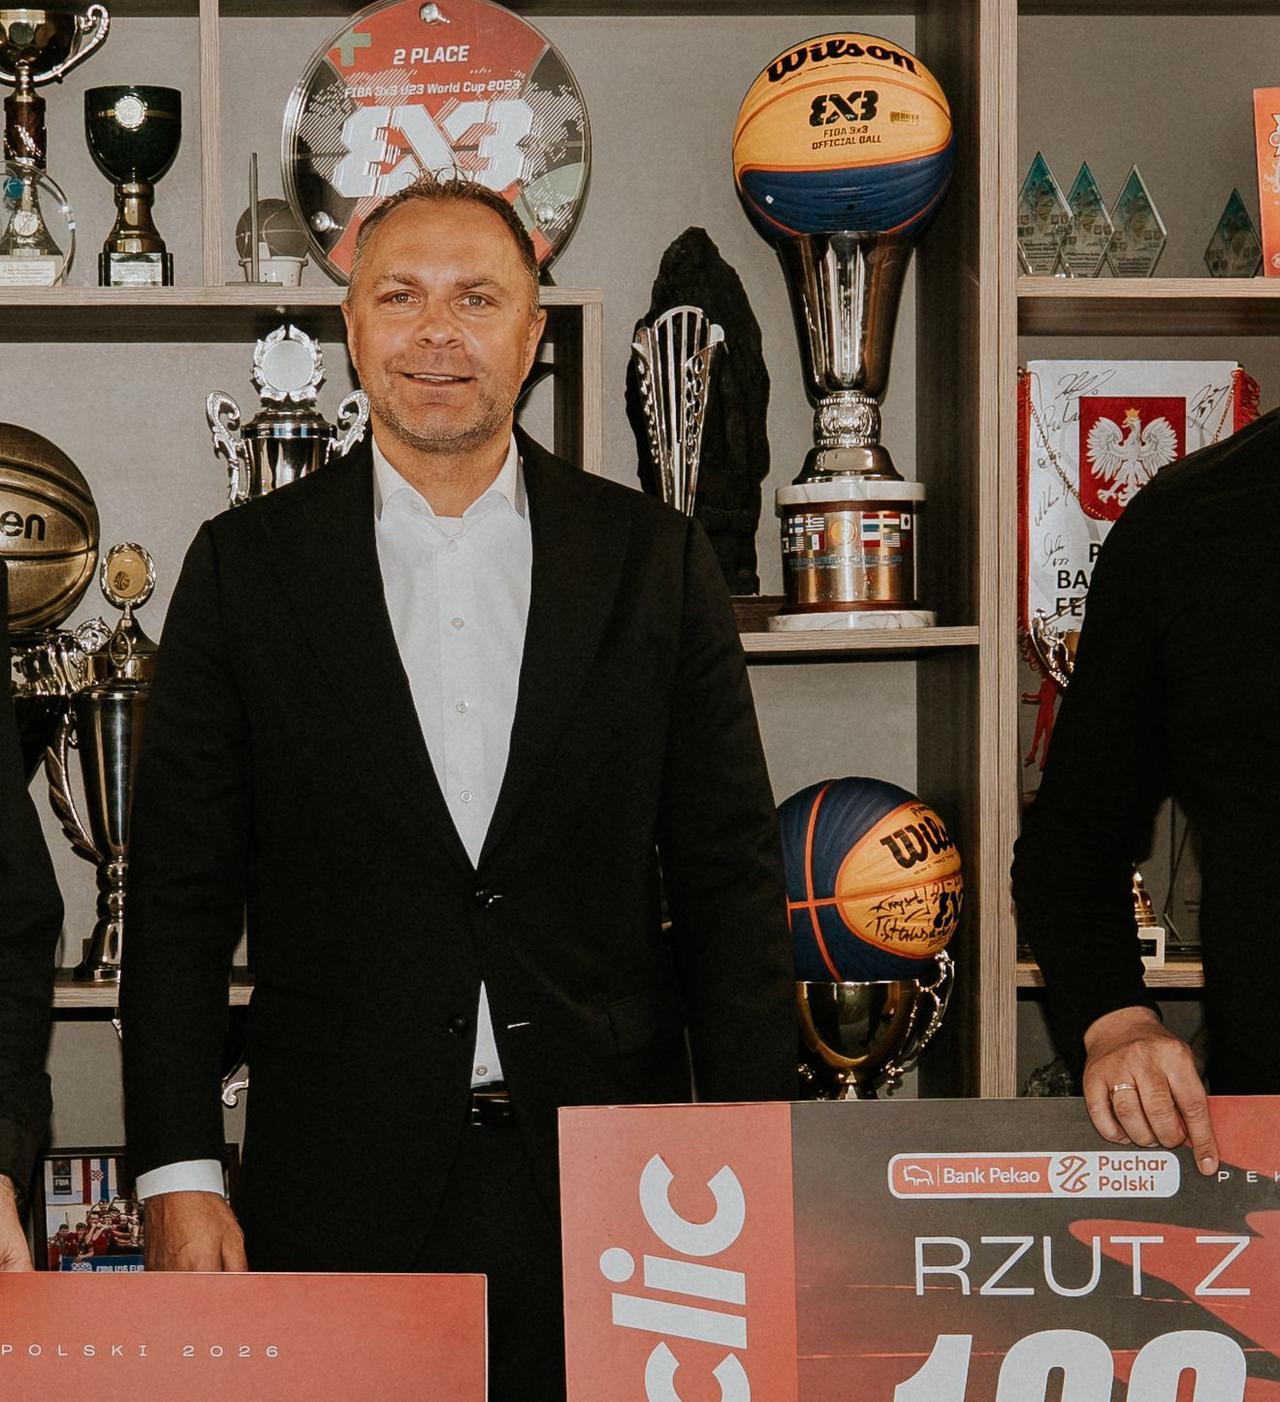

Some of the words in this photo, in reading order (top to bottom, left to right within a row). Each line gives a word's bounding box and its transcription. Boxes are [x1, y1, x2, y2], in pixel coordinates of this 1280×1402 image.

[393, 49, 406, 65] 2
[410, 45, 470, 64] PLACE
[767, 39, 921, 82] Wilson
[345, 87, 372, 98] FIBA
[401, 84, 425, 96] U23
[427, 82, 460, 94] World
[463, 82, 485, 95] Cup
[488, 79, 520, 91] 2023
[823, 127, 847, 138] FIBA
[812, 137, 857, 150] OFFICIAL
[858, 135, 882, 145] BALL
[1098, 1156, 1168, 1172] Puchar
[944, 1167, 985, 1184] Bank
[989, 1167, 1041, 1184] Pekao
[1098, 1175, 1155, 1192] Polski
[914, 1235, 1164, 1297] RZUT
[1194, 1235, 1251, 1296] Z
[1, 1344, 147, 1357] POLSKI
[183, 1344, 279, 1358] 2026
